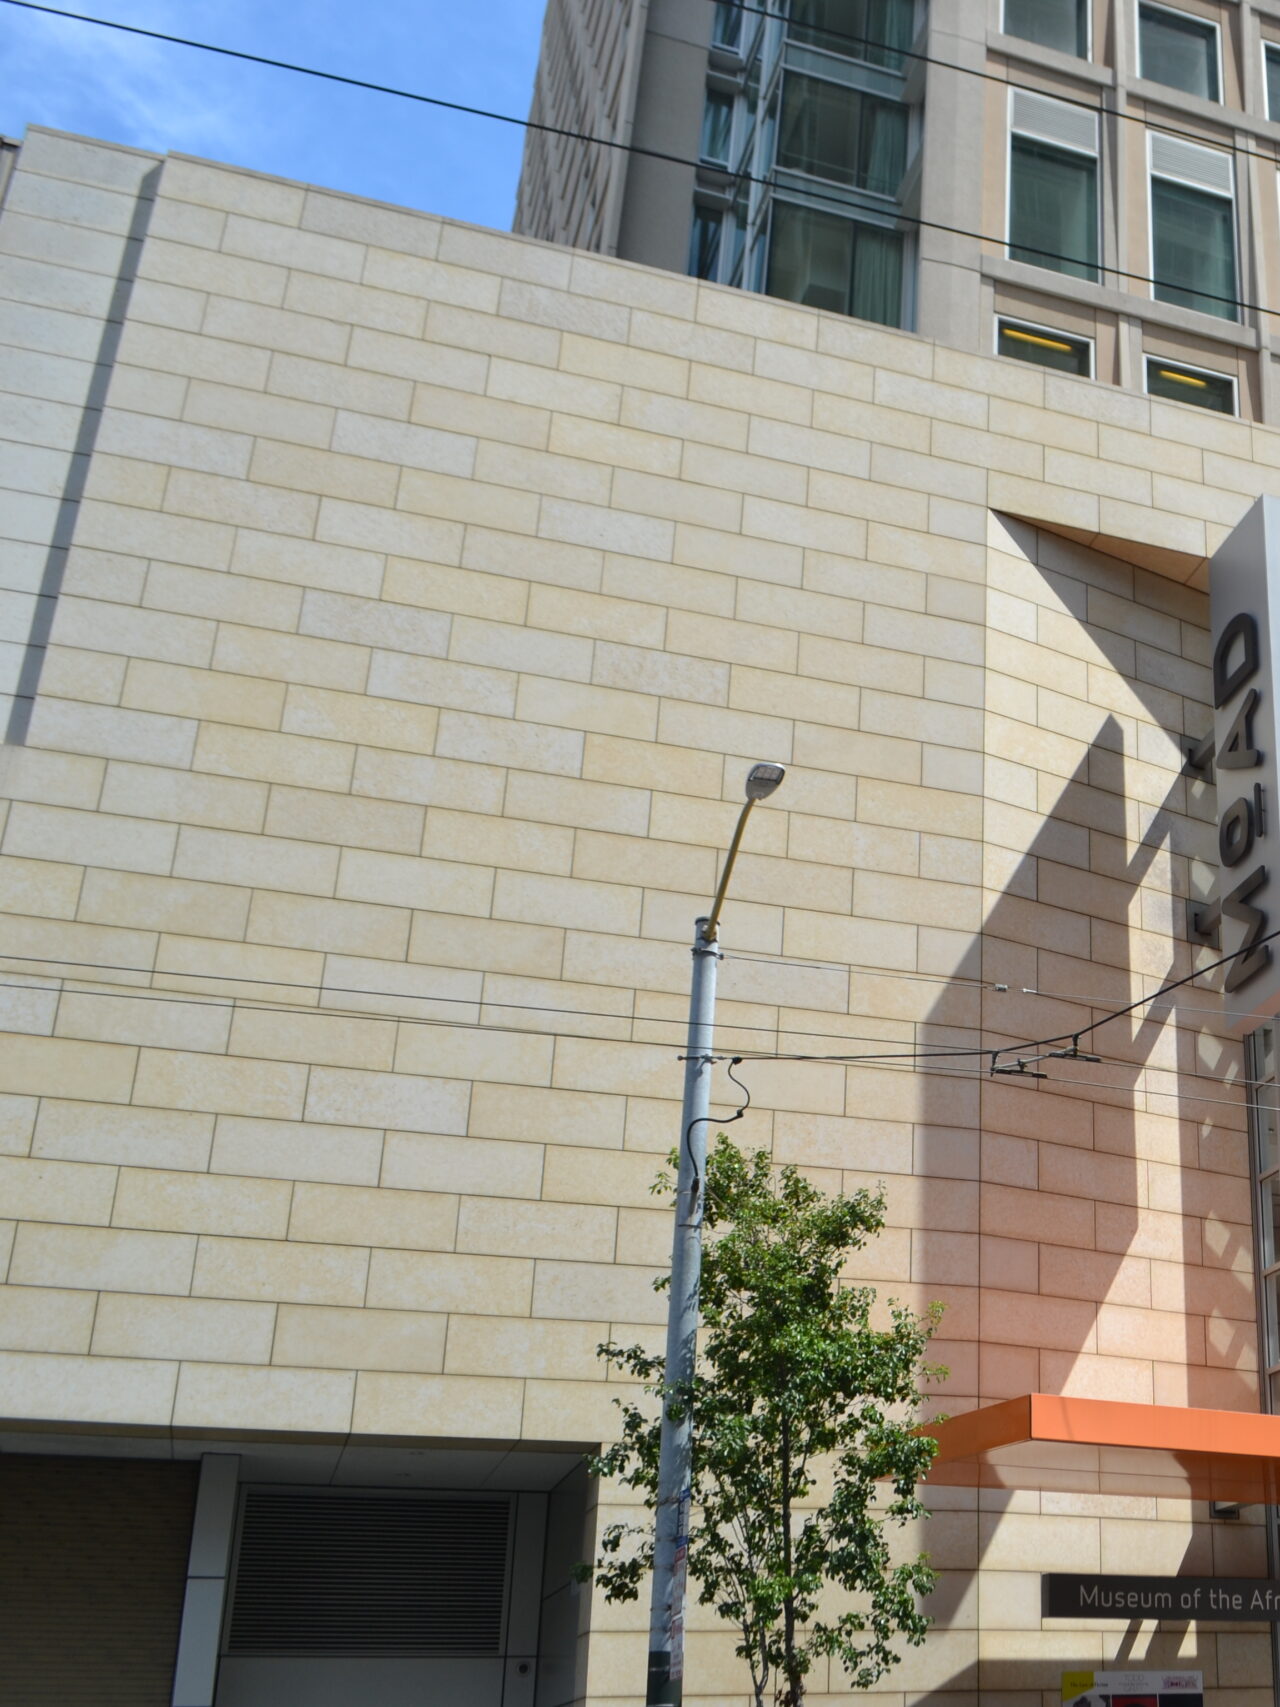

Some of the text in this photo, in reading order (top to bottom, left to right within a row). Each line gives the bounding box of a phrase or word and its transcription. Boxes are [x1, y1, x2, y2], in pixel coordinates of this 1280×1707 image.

[1079, 1584, 1172, 1609] Museum
[1180, 1587, 1201, 1610] of
[1208, 1588, 1243, 1610] the
